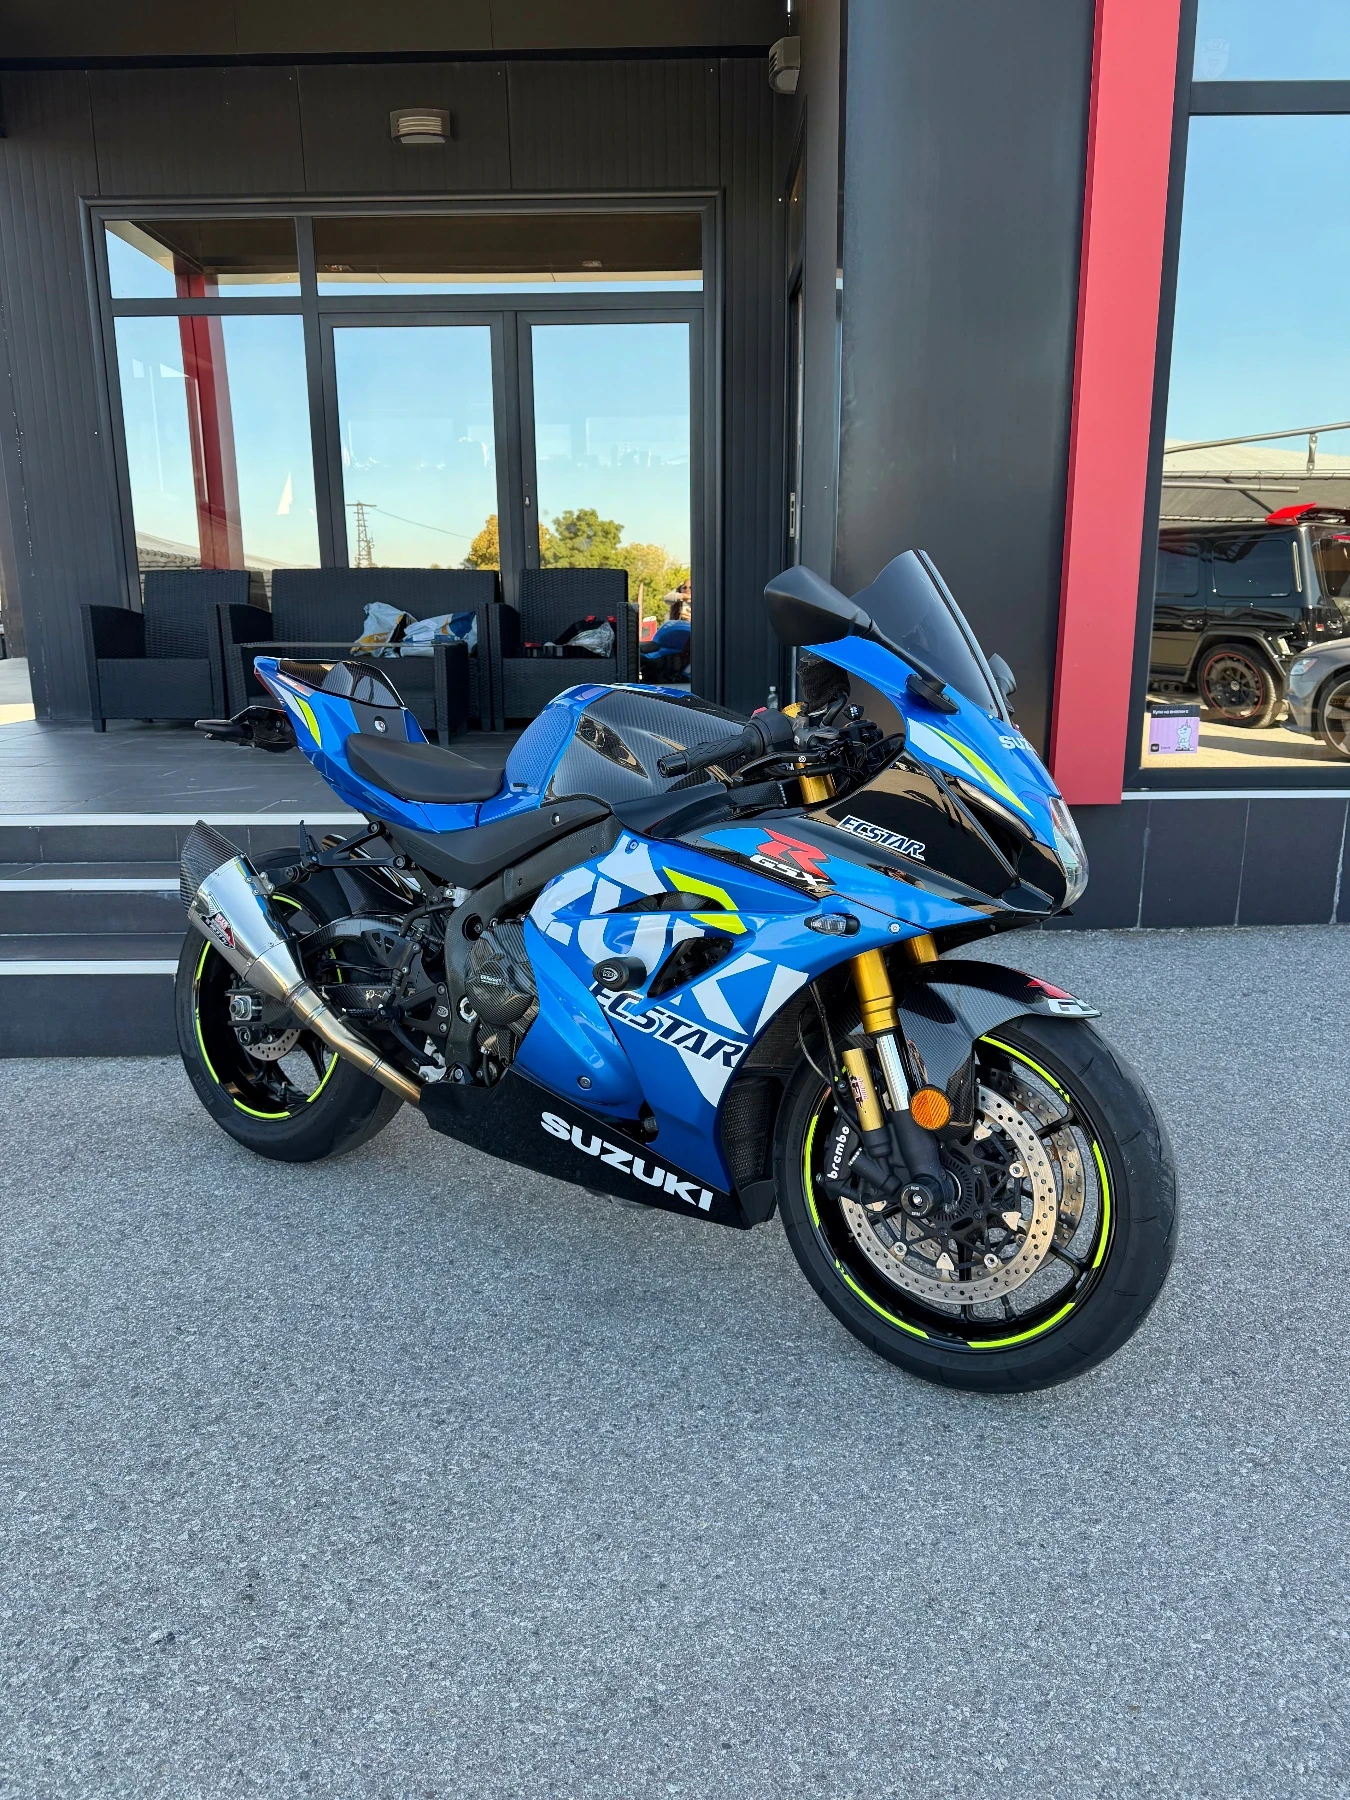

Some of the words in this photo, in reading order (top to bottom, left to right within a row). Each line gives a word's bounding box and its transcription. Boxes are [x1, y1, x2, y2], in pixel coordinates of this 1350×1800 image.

[756, 827, 831, 881] R
[837, 815, 926, 861] ECSTAR
[749, 854, 829, 887] GSX
[540, 1111, 714, 1212] SUZUKI
[826, 1125, 851, 1180] brembo
